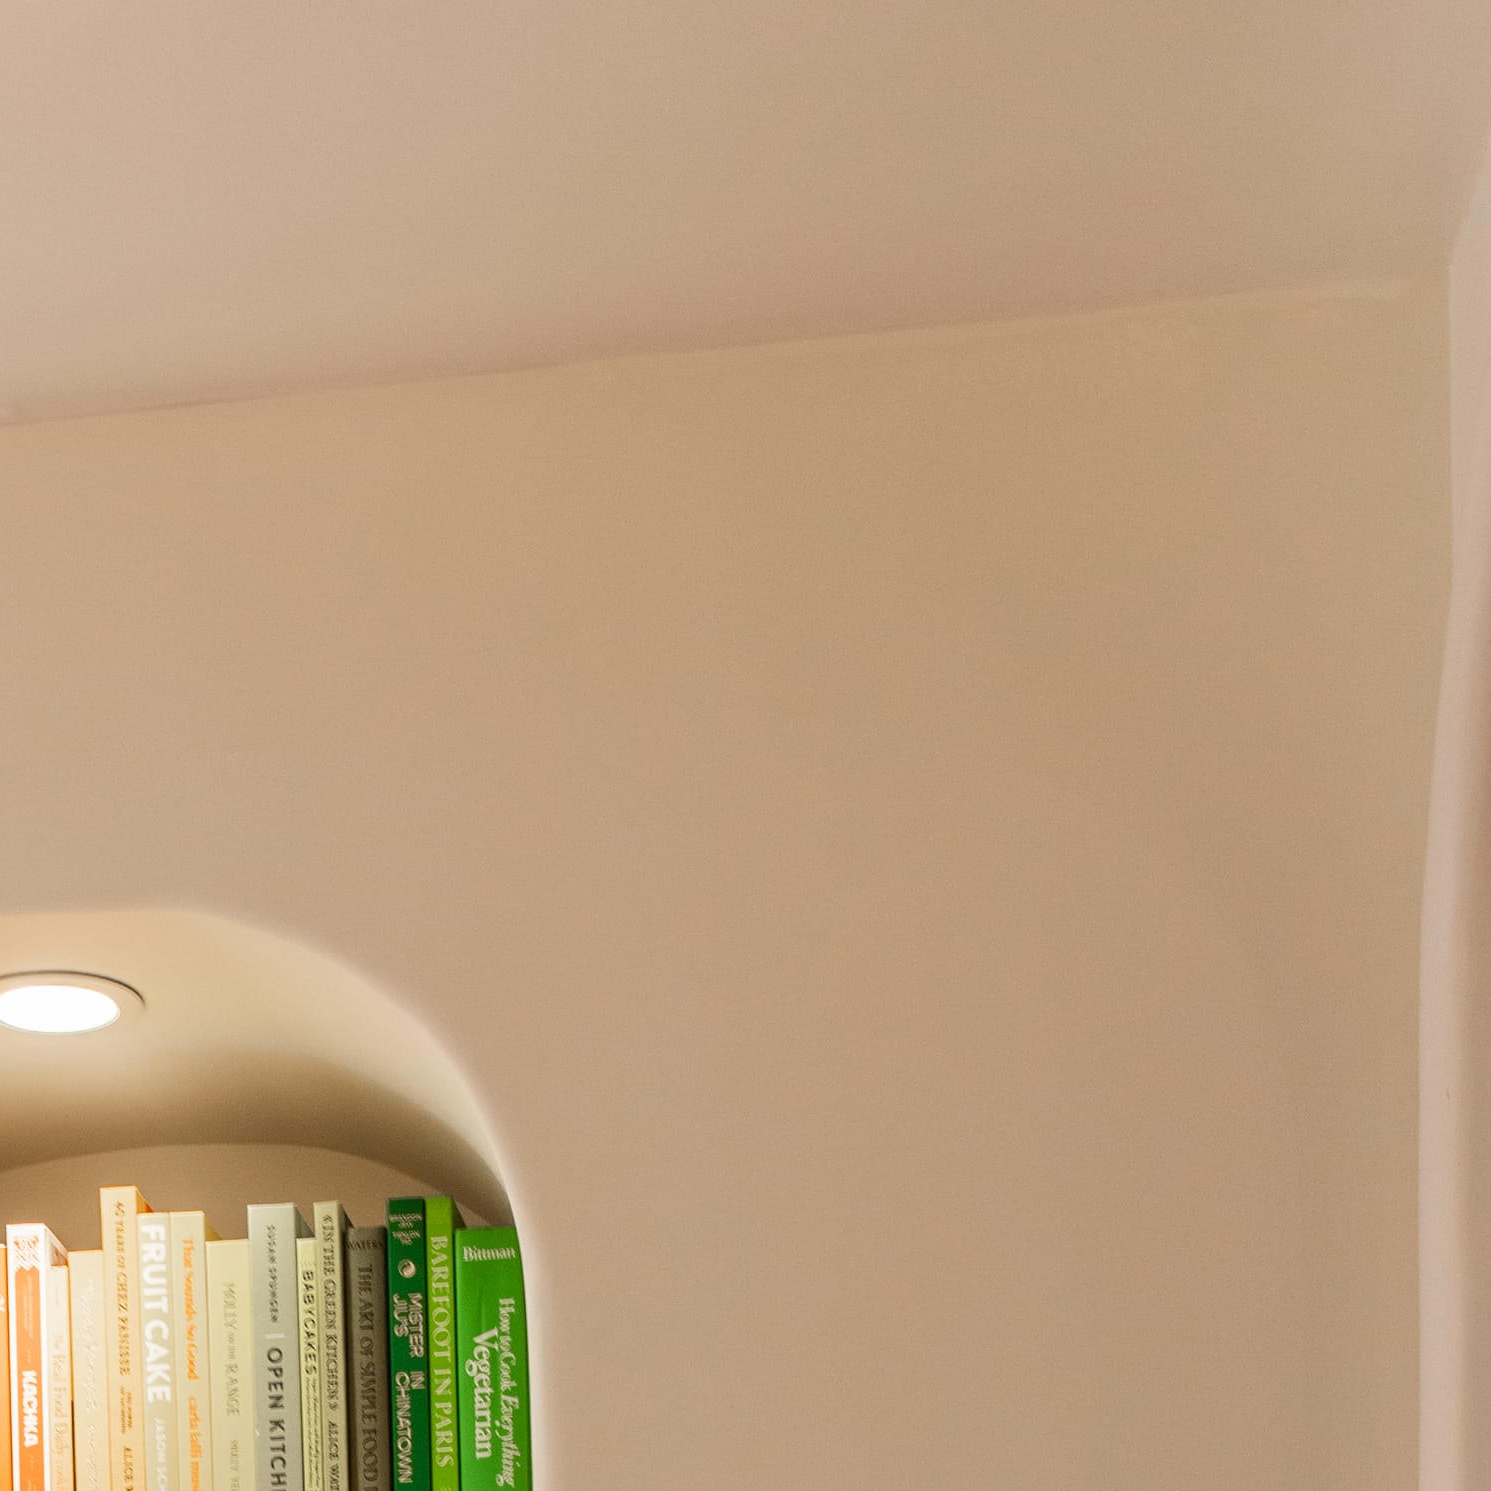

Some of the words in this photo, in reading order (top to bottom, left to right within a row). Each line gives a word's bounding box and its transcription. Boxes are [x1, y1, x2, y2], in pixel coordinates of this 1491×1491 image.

[141, 1223, 169, 1310] FRUIT
[266, 1224, 277, 1263] SUSAN
[462, 1245, 516, 1262] Bittman
[117, 1272, 128, 1312] CHEZ
[223, 1281, 237, 1330] MOLLY
[268, 1266, 280, 1324] SPUNGEN
[323, 1278, 337, 1331] GREEN
[356, 1264, 374, 1299] THE
[429, 1235, 451, 1363] BAREFOOT
[302, 1269, 317, 1376] BABYCAKES
[358, 1302, 375, 1336] ART
[407, 1293, 424, 1358] MISTER
[498, 1297, 515, 1333] How
[117, 1316, 131, 1376] PANISSE
[145, 1320, 171, 1403] CAKE
[186, 1343, 199, 1380] Good
[359, 1340, 374, 1359] OF
[499, 1334, 514, 1351] to
[225, 1363, 239, 1417] RANGE
[266, 1347, 285, 1410] OPEN
[359, 1361, 376, 1424] SIMPLE
[409, 1371, 425, 1389] IN
[433, 1368, 452, 1396] IN
[464, 1327, 500, 1460] Vegetarian
[500, 1351, 517, 1392] Cook
[20, 1369, 38, 1447] KACHKA
[395, 1371, 412, 1483] CHINATOWN
[154, 1418, 167, 1463] JASON
[328, 1421, 339, 1455] ALICE
[361, 1428, 378, 1481] FOOD
[434, 1402, 454, 1468] PARIS
[495, 1394, 519, 1487] Everything
[123, 1446, 134, 1482] ALICE
